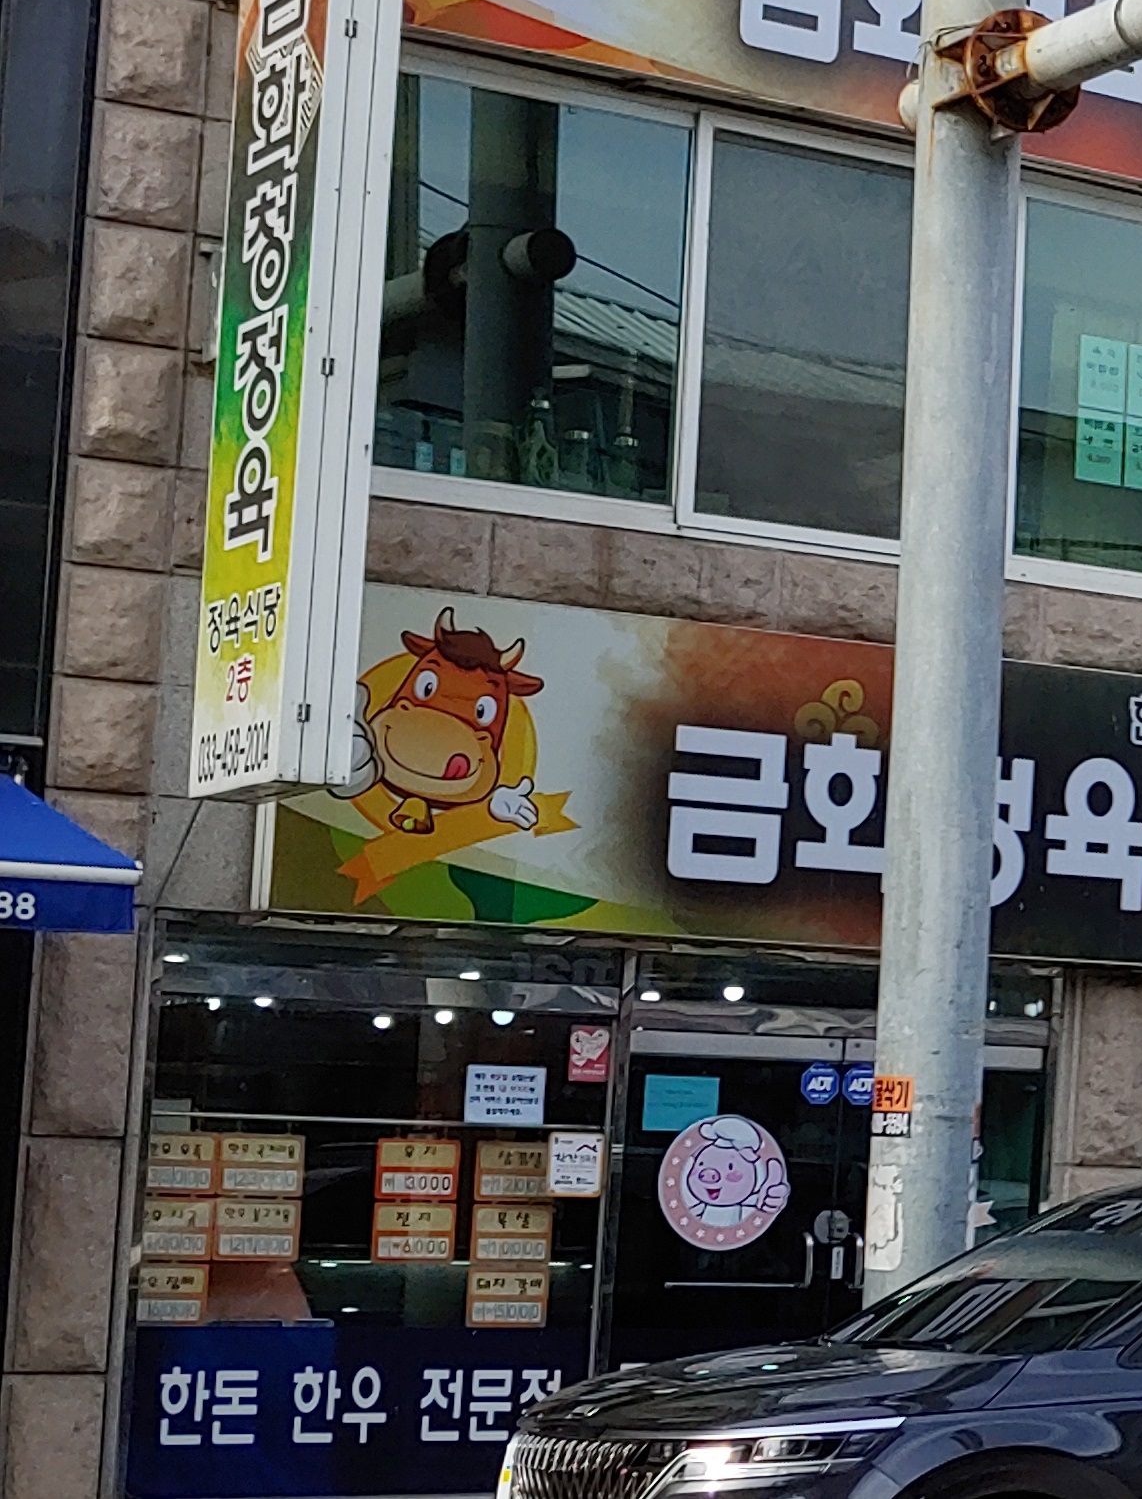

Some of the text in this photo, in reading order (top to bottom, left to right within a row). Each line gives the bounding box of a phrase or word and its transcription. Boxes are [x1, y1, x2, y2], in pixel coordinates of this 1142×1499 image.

[207, 585, 281, 653] 정육식당
[226, 656, 252, 703] 2층
[197, 720, 272, 784] 033-458-2004
[806, 1075, 835, 1092] ADT
[848, 1077, 874, 1093] ADT
[159, 1366, 260, 1446] 한돈
[292, 1366, 388, 1445] 한우
